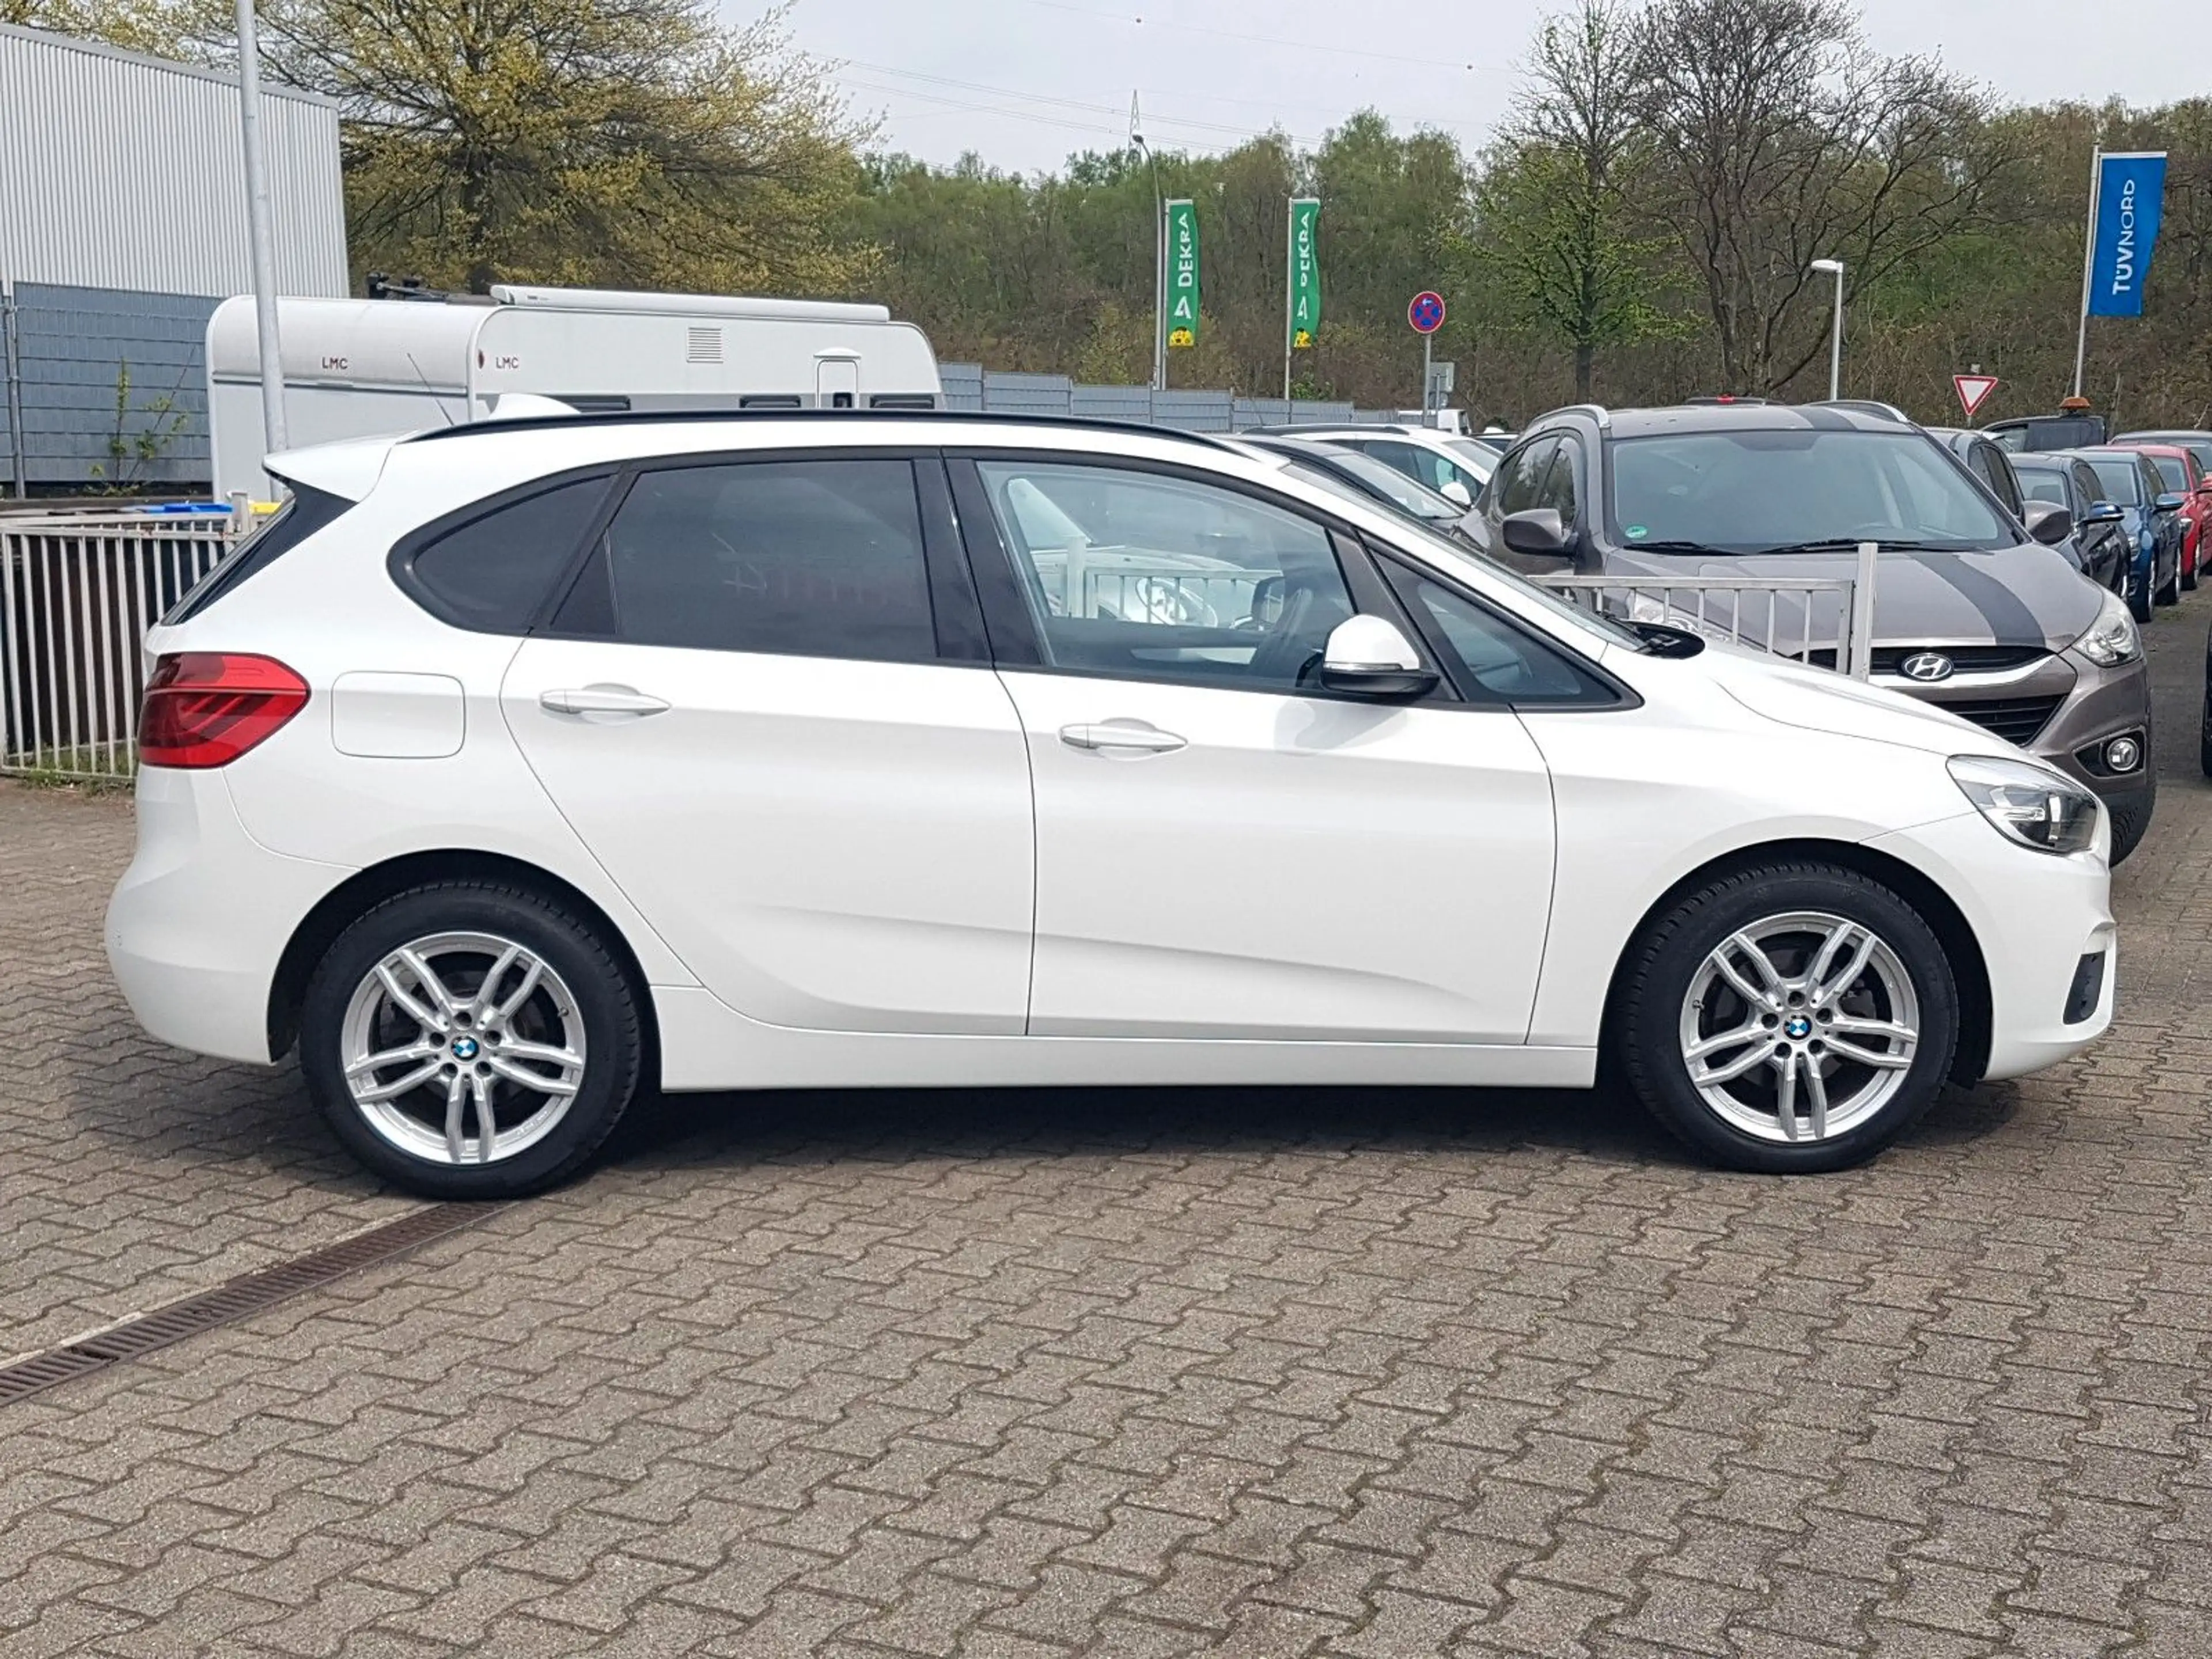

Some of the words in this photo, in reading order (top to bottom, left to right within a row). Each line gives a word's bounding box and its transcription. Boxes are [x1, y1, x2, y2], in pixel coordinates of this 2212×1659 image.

[1178, 212, 1193, 287] DEKRA
[321, 357, 348, 369] LMC
[496, 357, 519, 369] LMC
